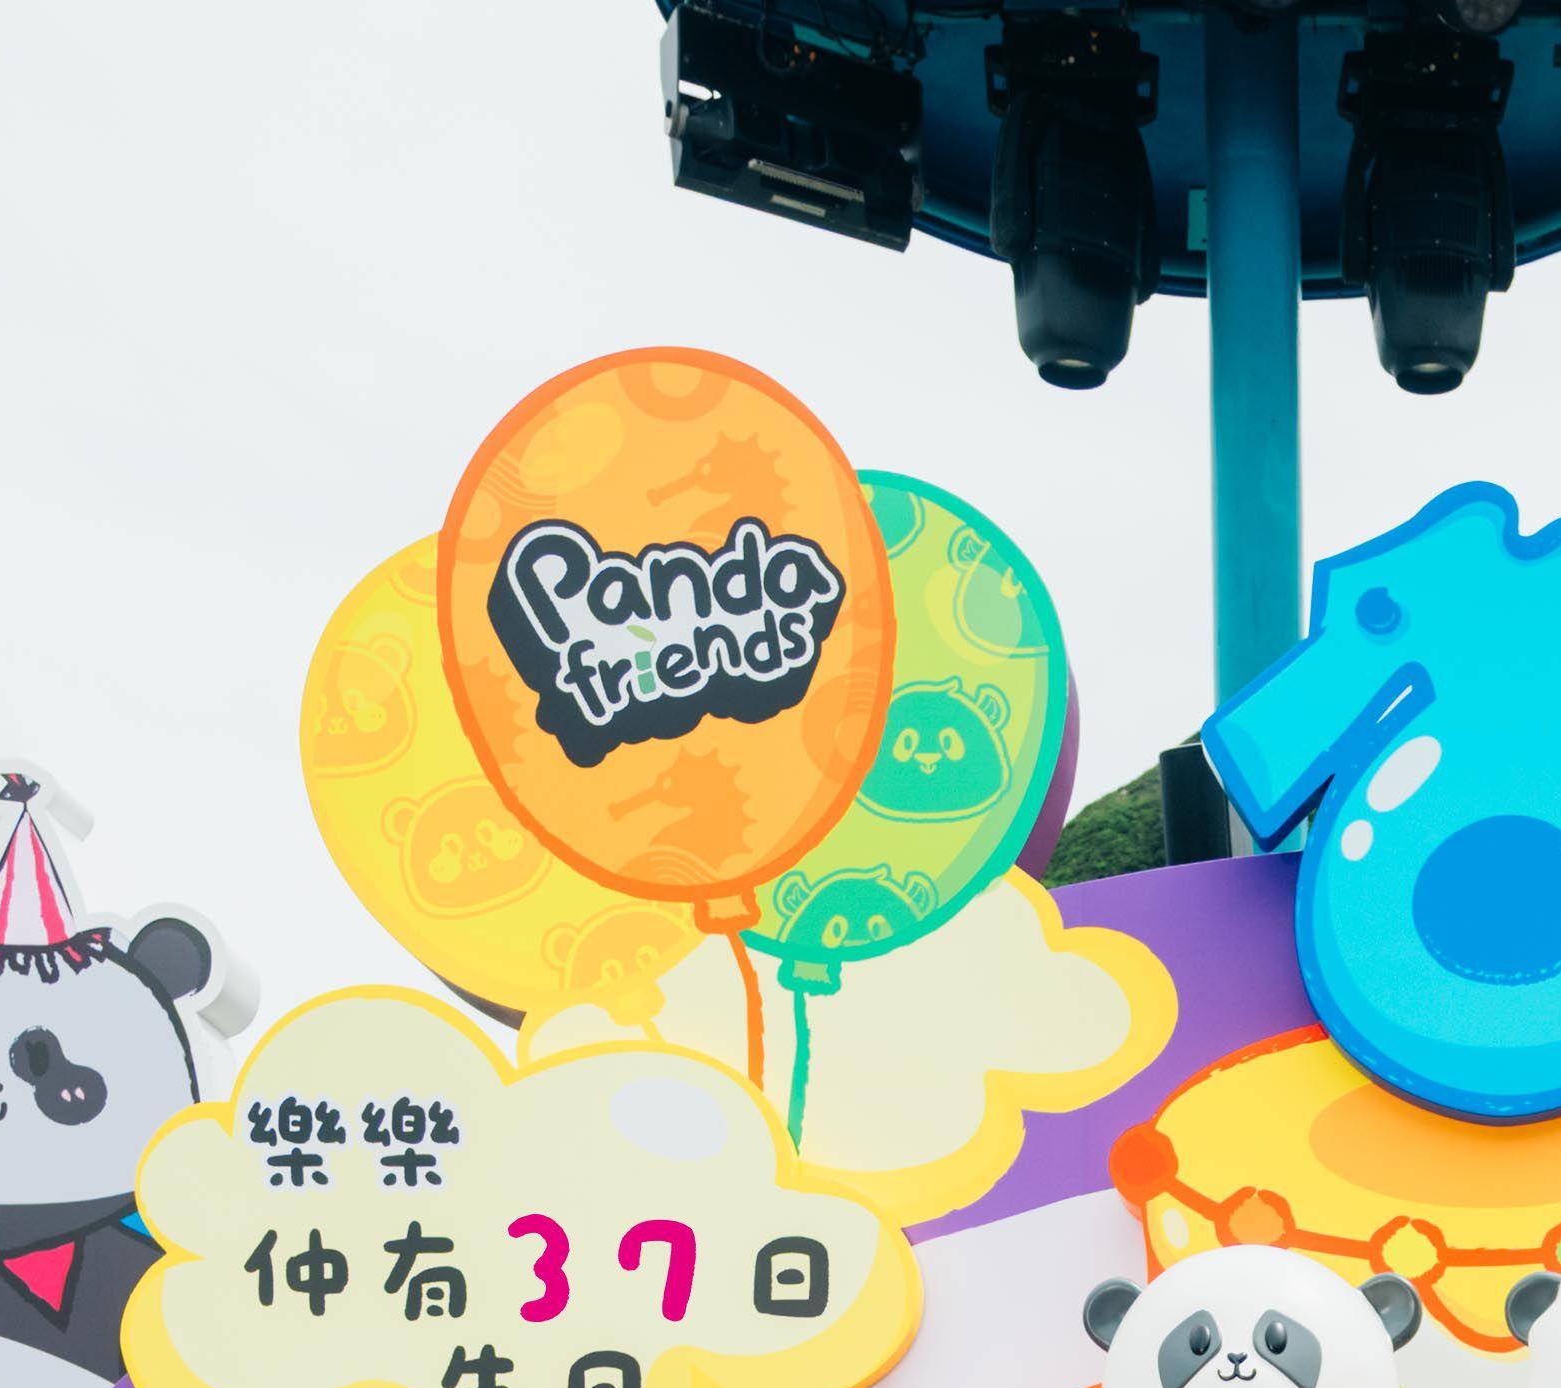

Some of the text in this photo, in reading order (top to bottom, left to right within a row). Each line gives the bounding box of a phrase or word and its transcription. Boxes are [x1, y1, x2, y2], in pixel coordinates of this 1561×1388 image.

[514, 531, 832, 644] Panda
[563, 609, 807, 718] friends
[248, 1096, 460, 1187] 樂樂
